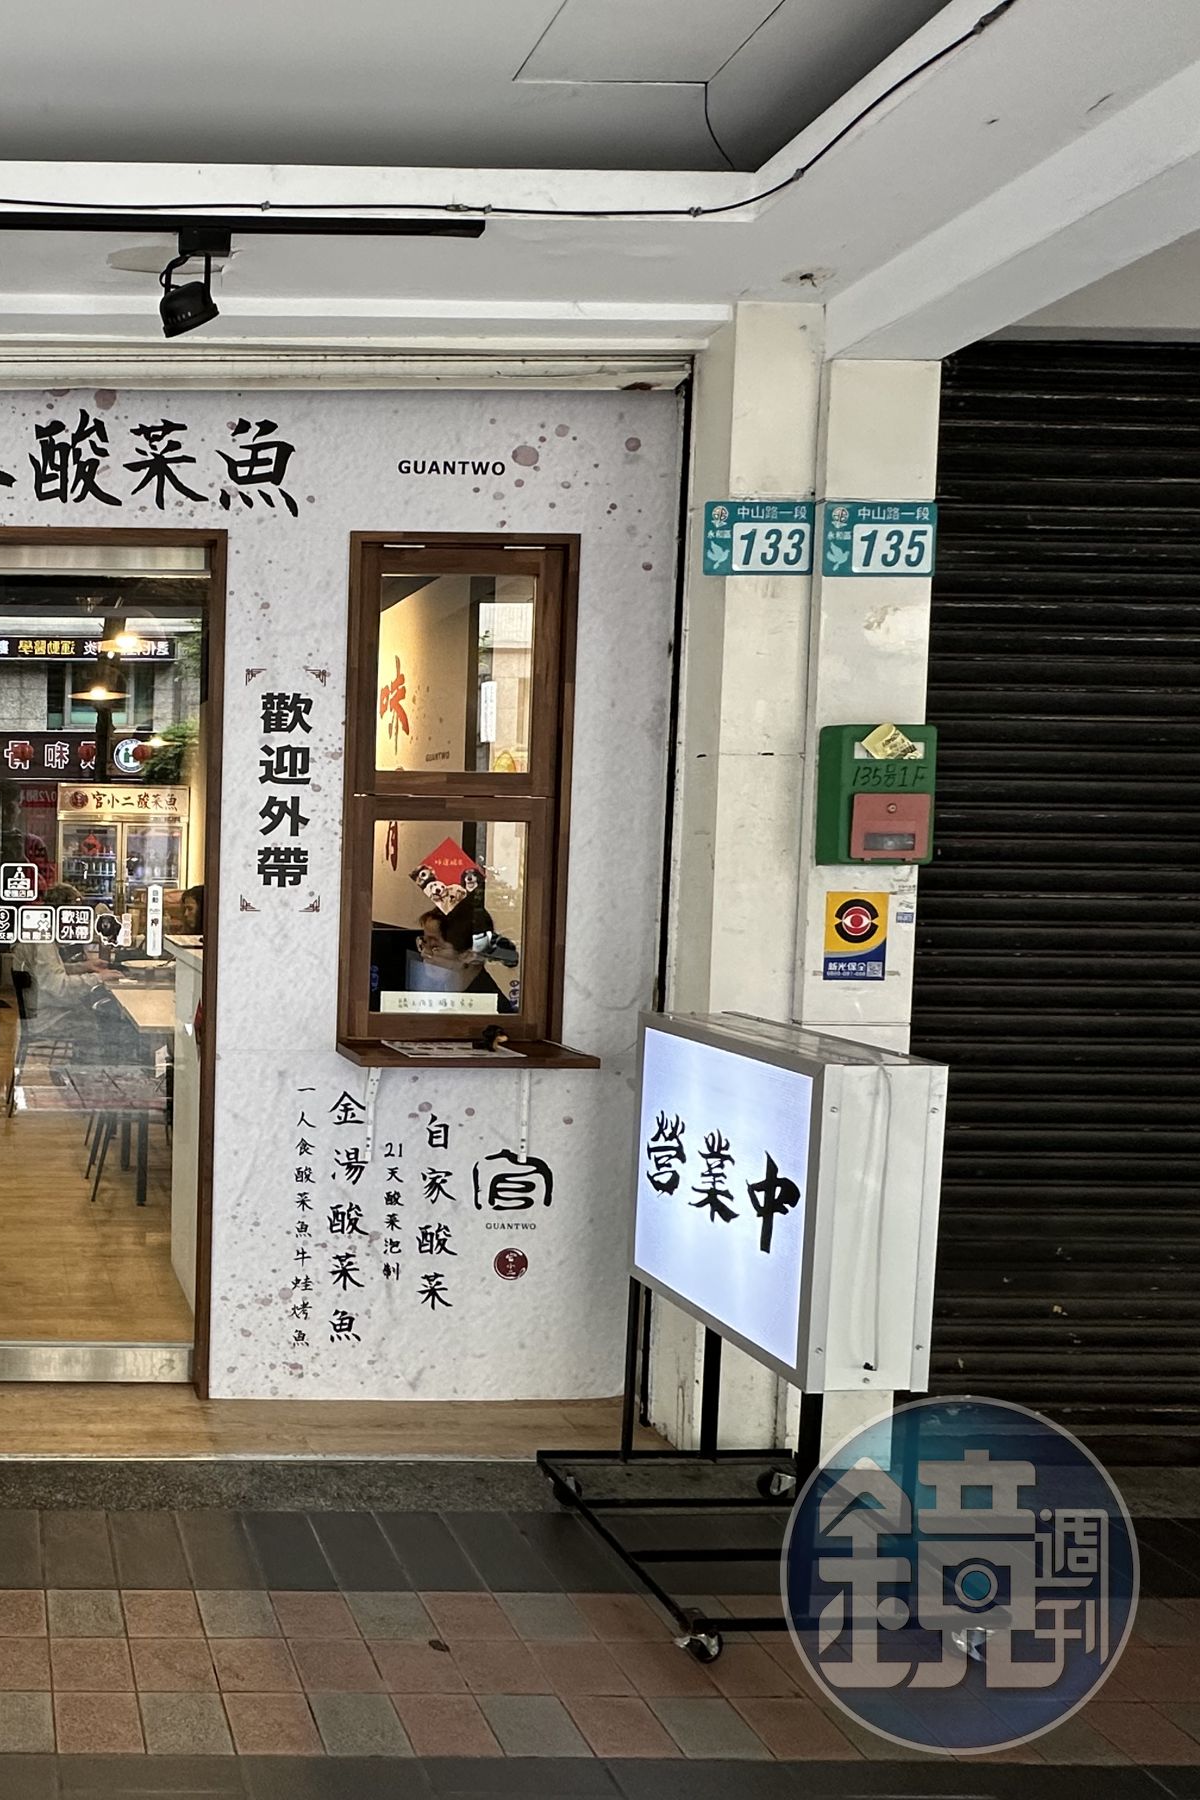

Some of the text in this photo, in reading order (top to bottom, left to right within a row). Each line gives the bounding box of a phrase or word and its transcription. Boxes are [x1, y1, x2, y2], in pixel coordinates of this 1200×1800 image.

[398, 460, 506, 476] GUANTWO
[737, 505, 807, 520] 中山路一段
[858, 506, 930, 521] 中山路一段
[739, 528, 806, 566] 133
[860, 529, 928, 567] 135
[257, 692, 314, 888] 歡迎外帶
[61, 910, 89, 925] 歡迎
[61, 925, 89, 940] 外帶
[646, 1110, 801, 1254] 營業中
[291, 1086, 317, 1347] 一人食酸菜魚牛蛙烤魚
[327, 1090, 369, 1343] 金湯酸菜魚
[416, 1114, 458, 1310] 自家酸菜
[485, 1222, 537, 1230] GUANTWO
